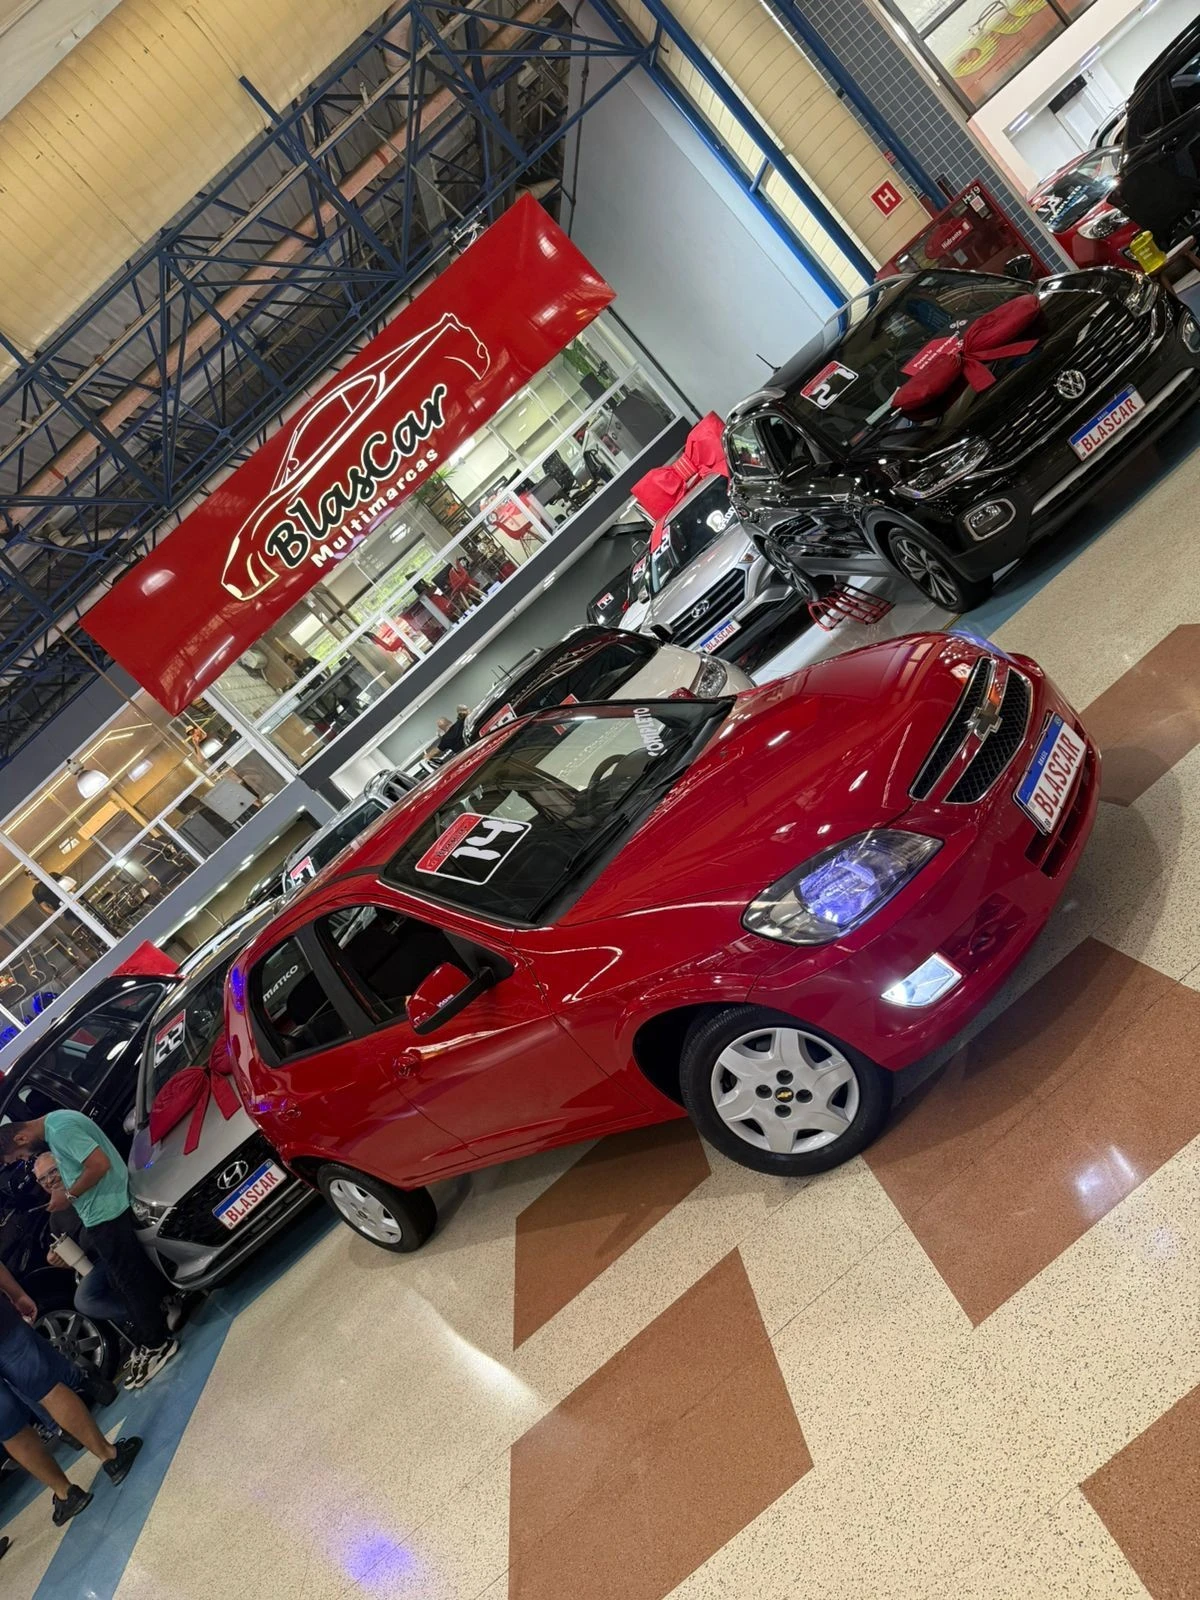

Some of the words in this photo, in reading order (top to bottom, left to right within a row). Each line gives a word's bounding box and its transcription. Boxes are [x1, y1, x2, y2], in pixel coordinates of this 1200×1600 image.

[878, 189, 897, 209] H
[962, 185, 982, 204] H-19
[941, 228, 963, 249] Hidrante
[1081, 398, 1138, 452] BLASCAR
[265, 384, 447, 569] BlasCar
[311, 448, 439, 568] Multimarcas
[705, 624, 735, 650] BLASCAR
[1033, 733, 1080, 818] BLASCAR
[1038, 750, 1048, 766] BRASIL
[452, 821, 524, 861] 14
[157, 1022, 182, 1063] 22
[225, 1171, 279, 1223] BLASCAR
